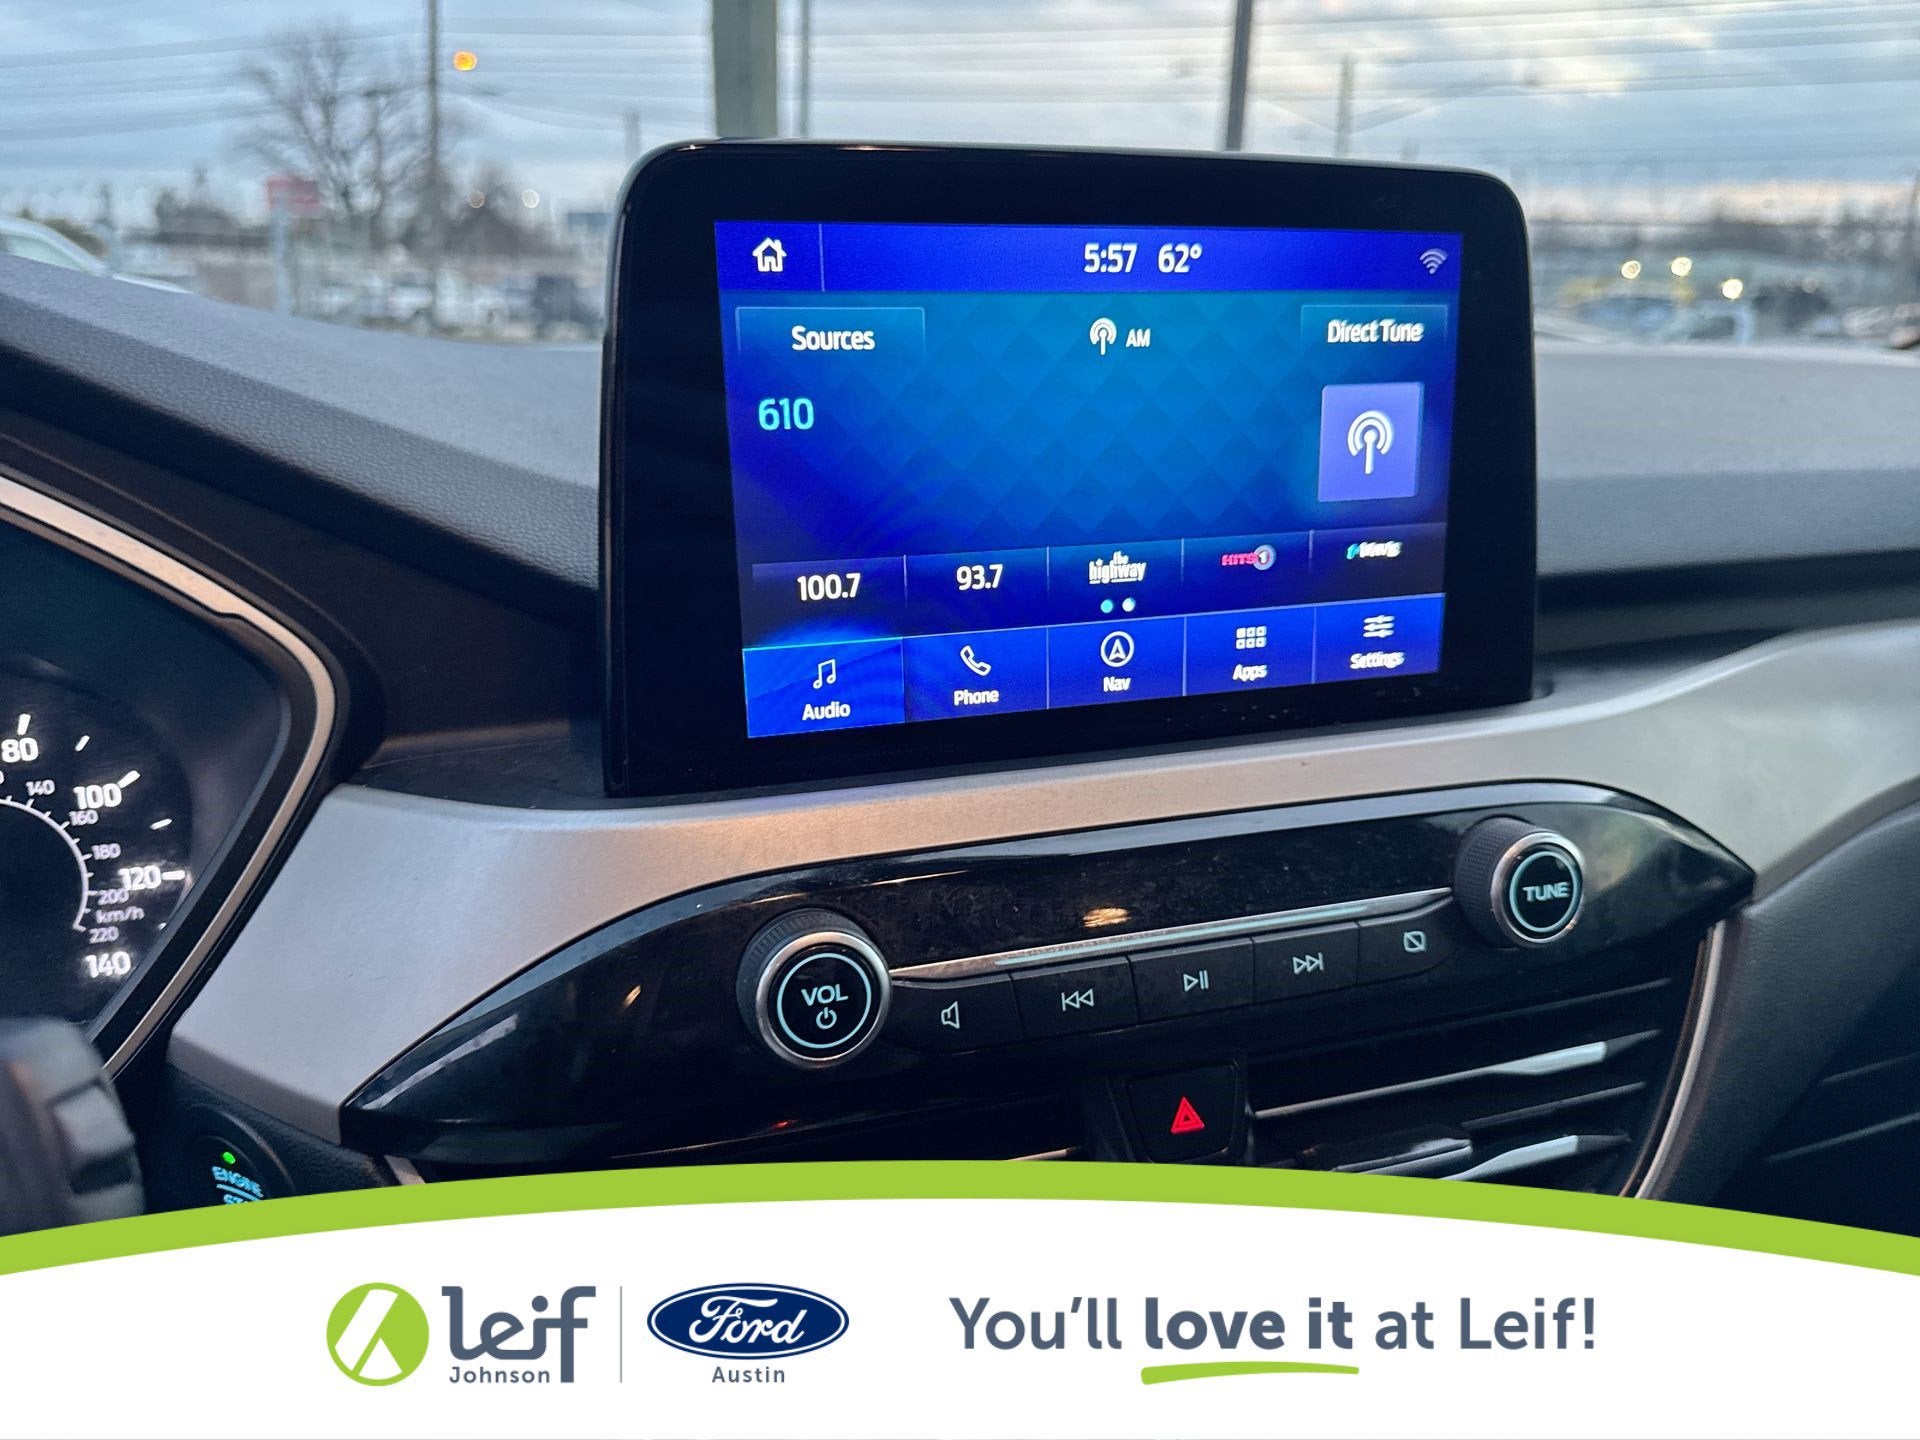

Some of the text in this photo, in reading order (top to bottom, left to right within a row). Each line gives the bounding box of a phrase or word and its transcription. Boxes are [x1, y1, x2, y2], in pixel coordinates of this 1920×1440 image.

[1083, 243, 1138, 273] 5:57
[790, 325, 876, 352] Sources
[1125, 330, 1151, 349] AM
[1326, 319, 1425, 344] Direct Tune
[757, 396, 815, 432] 610
[957, 565, 1003, 590] 93.7
[1089, 560, 1146, 584] highway
[797, 573, 861, 601] 100.7
[1350, 651, 1403, 670] Settings
[1232, 664, 1267, 682] Apps
[1103, 676, 1130, 693] Nav
[953, 687, 999, 706] Phone
[803, 699, 851, 720] Audio
[1, 738, 39, 763] 80
[26, 779, 55, 796] 140
[73, 783, 122, 808] 100
[69, 810, 99, 826] 160
[92, 843, 121, 860] 180
[118, 865, 161, 890] 120
[98, 889, 129, 905] 200
[1522, 883, 1570, 904] TUNE
[89, 927, 119, 944] 220
[85, 951, 131, 979] 140
[801, 984, 849, 1008] VOL
